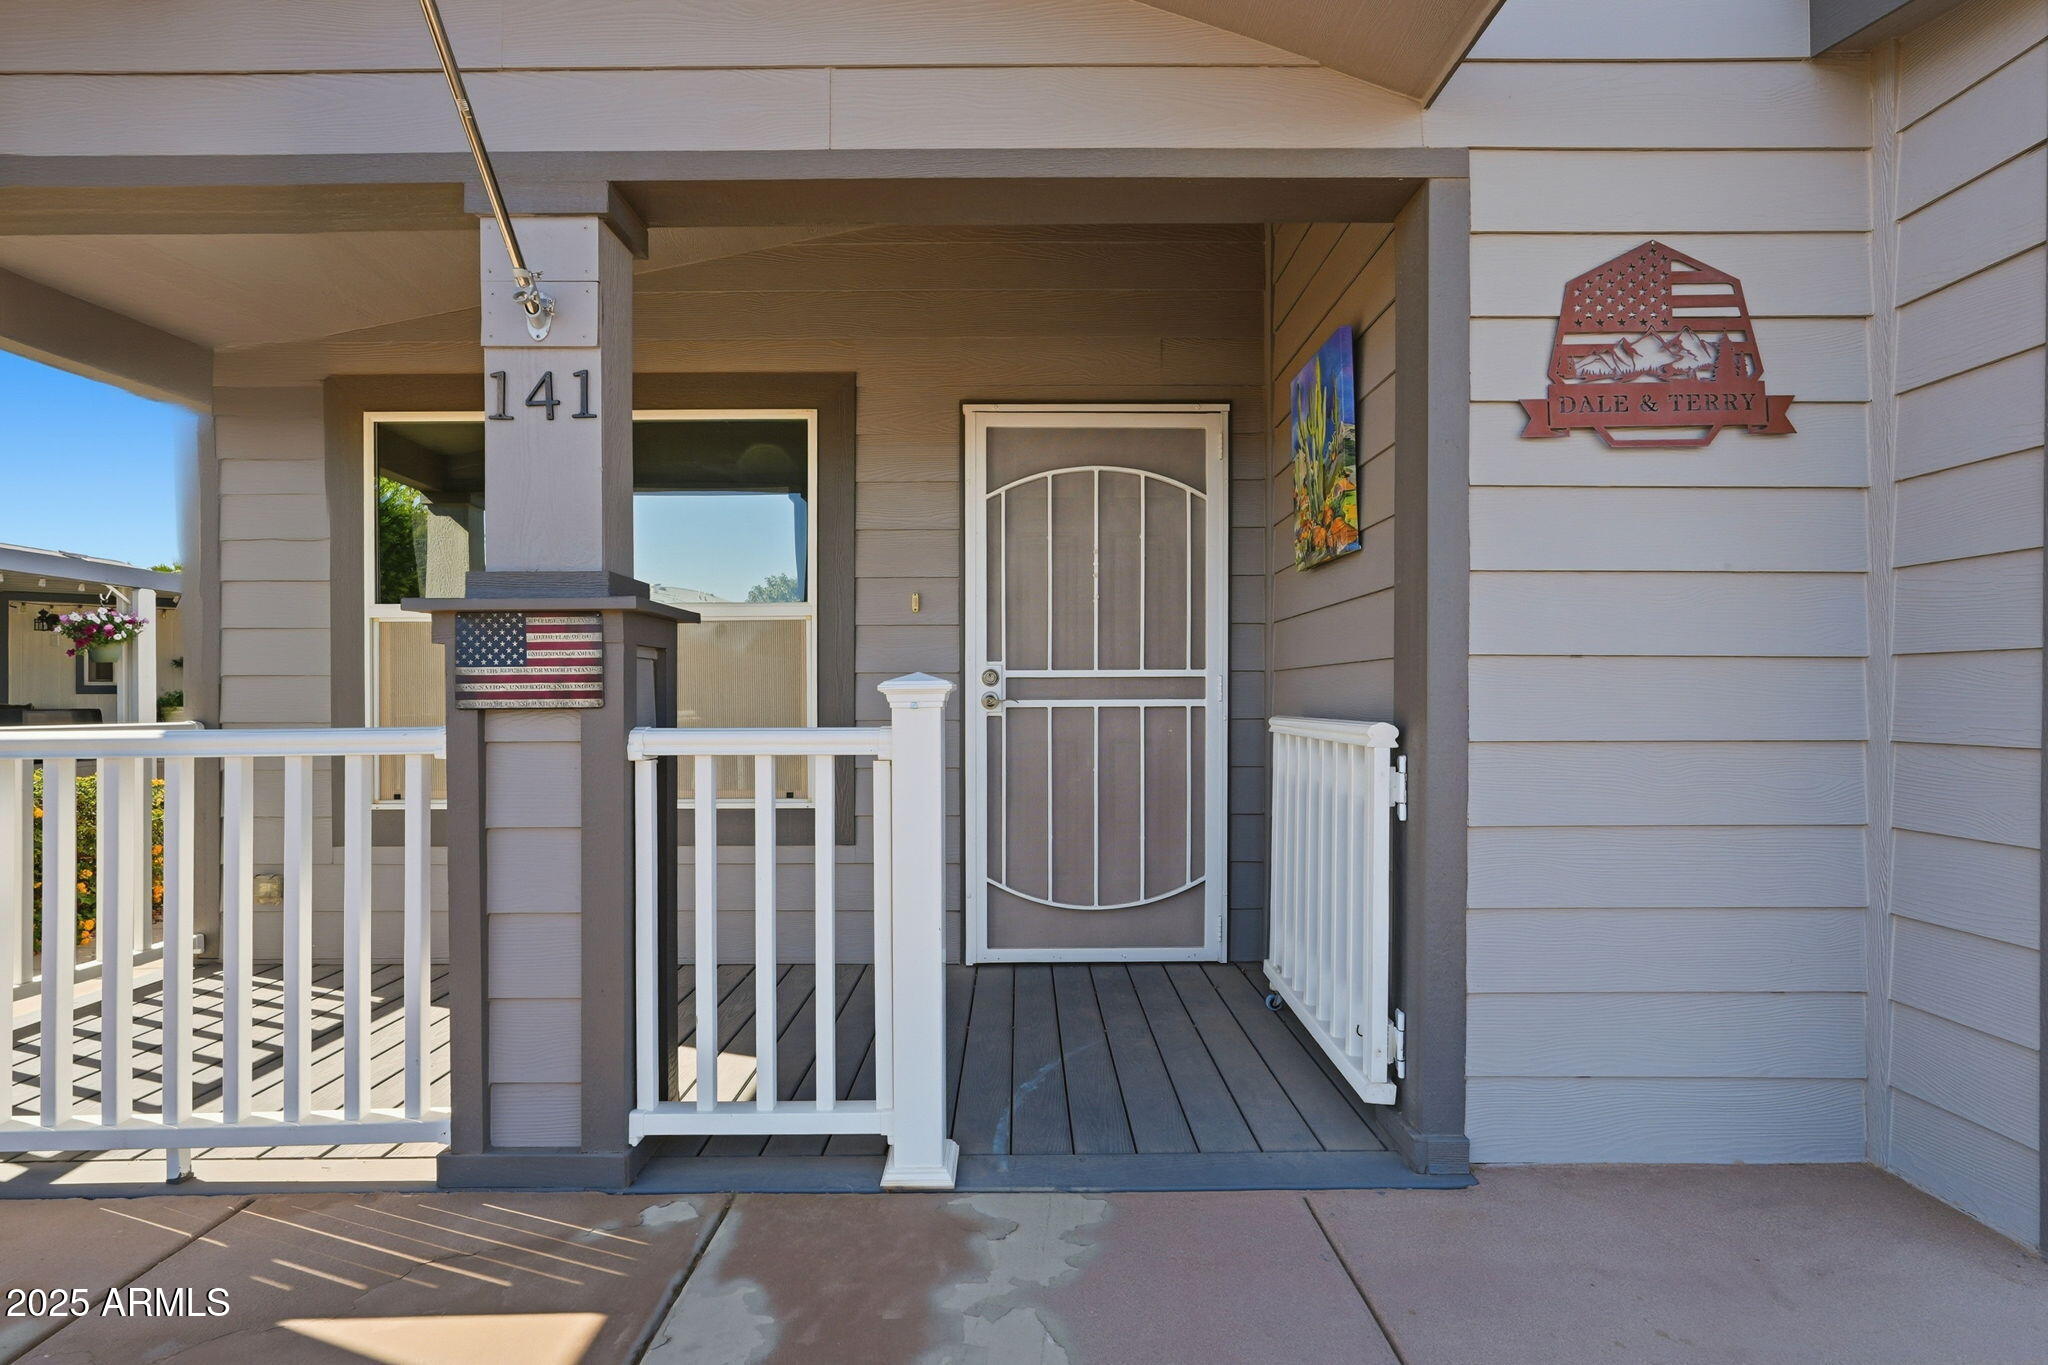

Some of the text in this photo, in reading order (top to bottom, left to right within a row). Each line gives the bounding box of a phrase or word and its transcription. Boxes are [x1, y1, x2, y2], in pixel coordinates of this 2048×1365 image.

[488, 369, 598, 421] 141
[1559, 392, 1757, 414] DALE & TERRY
